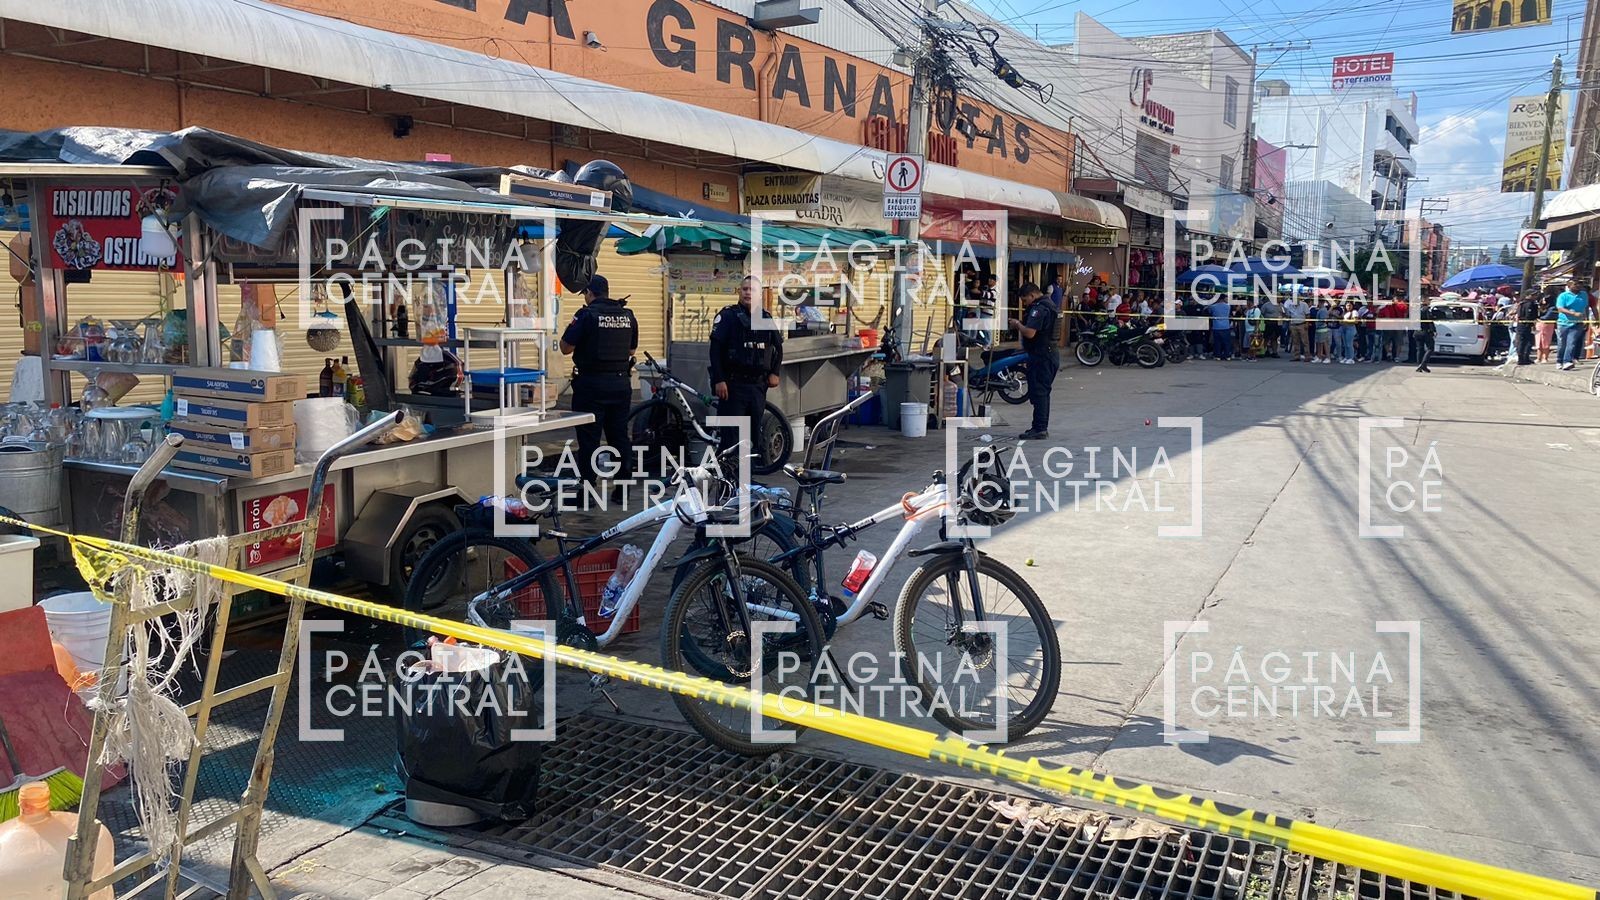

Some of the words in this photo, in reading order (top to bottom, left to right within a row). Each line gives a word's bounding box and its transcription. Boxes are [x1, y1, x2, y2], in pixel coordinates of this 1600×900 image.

[1334, 57, 1391, 74] HOTEL
[647, 0, 1031, 164] GRANAITAS
[1509, 120, 1565, 129] BIENVENOS
[764, 175, 799, 187] ENTRADA
[52, 190, 131, 217] ENSALADAS
[745, 194, 769, 206] PLAZA
[771, 192, 819, 205] GRANADITAS
[103, 236, 177, 267] OSTIO
